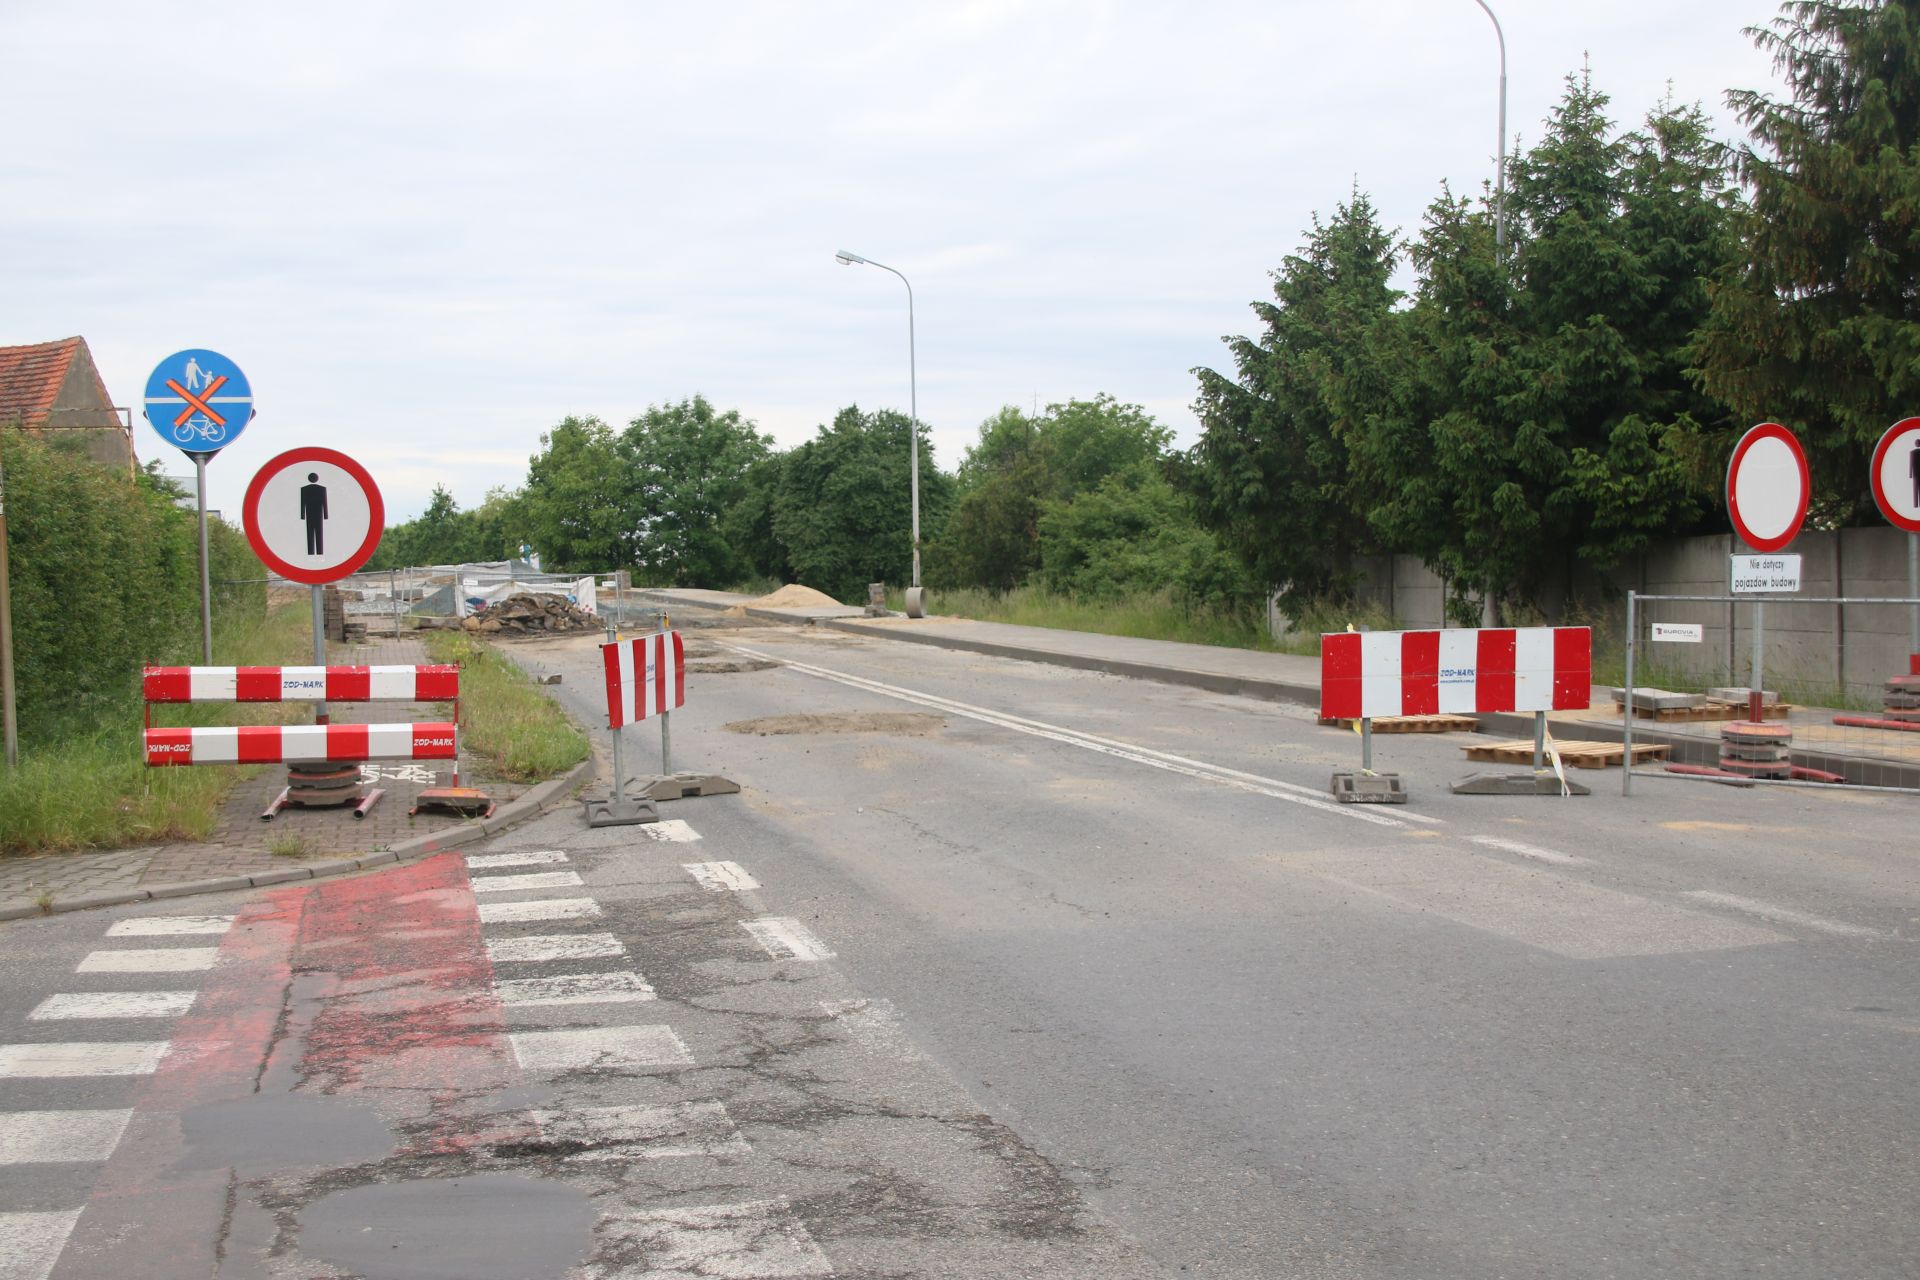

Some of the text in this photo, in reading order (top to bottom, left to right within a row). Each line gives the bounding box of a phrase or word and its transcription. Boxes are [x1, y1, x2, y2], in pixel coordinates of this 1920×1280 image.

[1749, 559, 1785, 571] Nie dotyczy
[1734, 576, 1797, 591] pojazdów budowy
[1440, 669, 1475, 677] ZOD-MARK
[283, 680, 324, 689] ZOD-MARK
[413, 738, 454, 746] ZOD-MARK
[148, 744, 191, 752] ZOD-MARK
